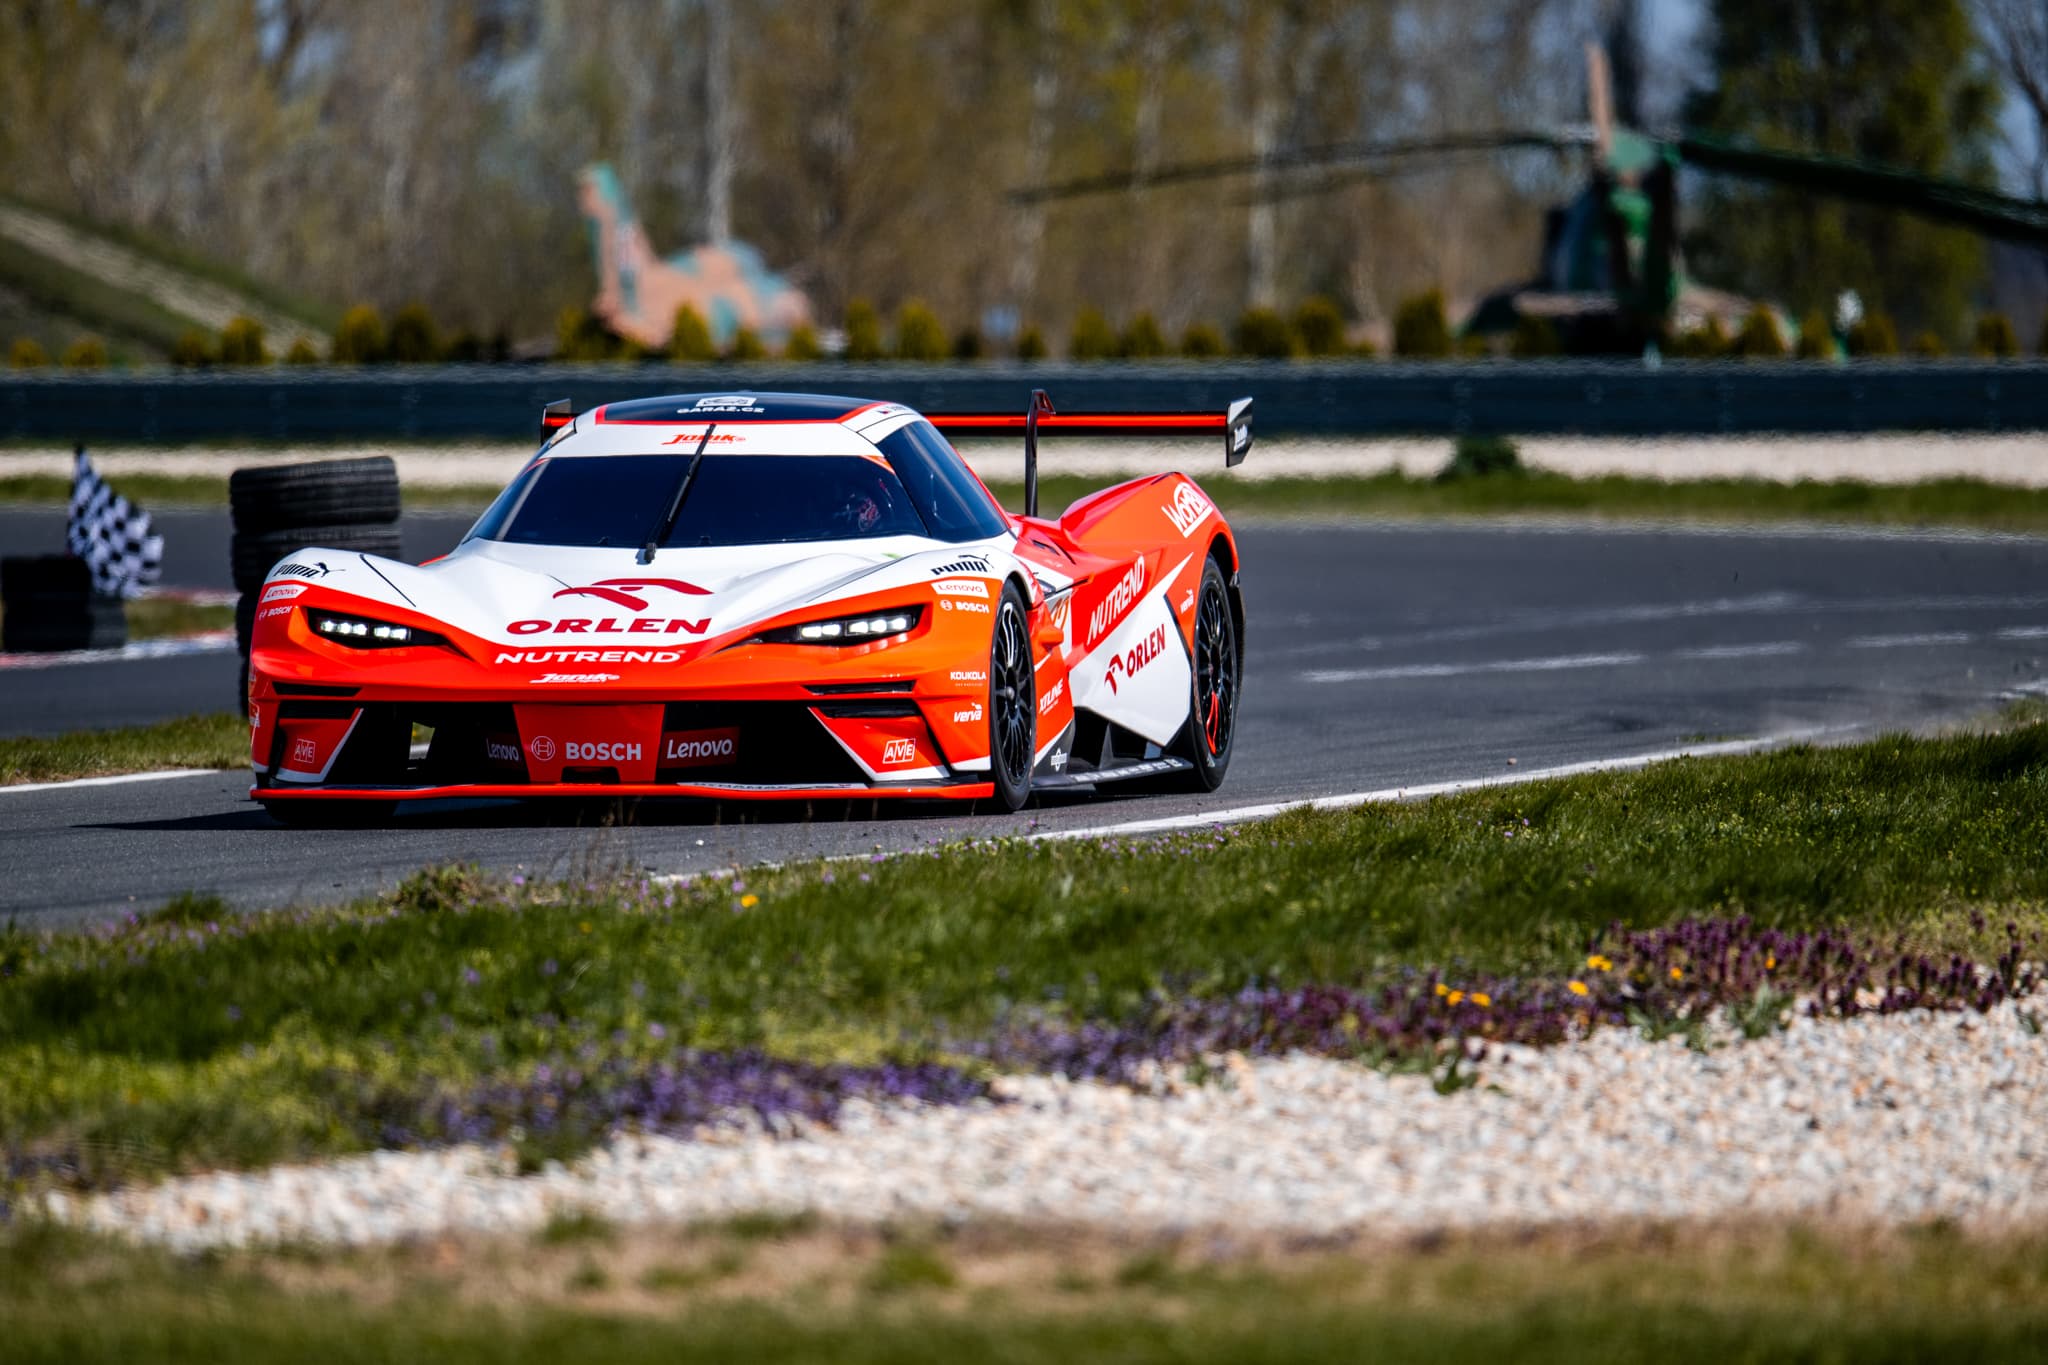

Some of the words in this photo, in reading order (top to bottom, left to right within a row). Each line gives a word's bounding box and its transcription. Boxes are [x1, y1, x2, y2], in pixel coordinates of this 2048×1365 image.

[930, 561, 988, 575] PUMA
[938, 584, 983, 593] Lenovo
[955, 601, 990, 614] BOSCH
[1086, 555, 1145, 646] NUTREND
[506, 617, 712, 635] ORLEN
[494, 650, 681, 664] NUTREND
[1126, 623, 1165, 678] ORLEN
[953, 710, 983, 723] verva
[486, 738, 520, 761] Lenovo
[565, 742, 642, 761] BOSCH
[667, 738, 735, 759] Lenovo
